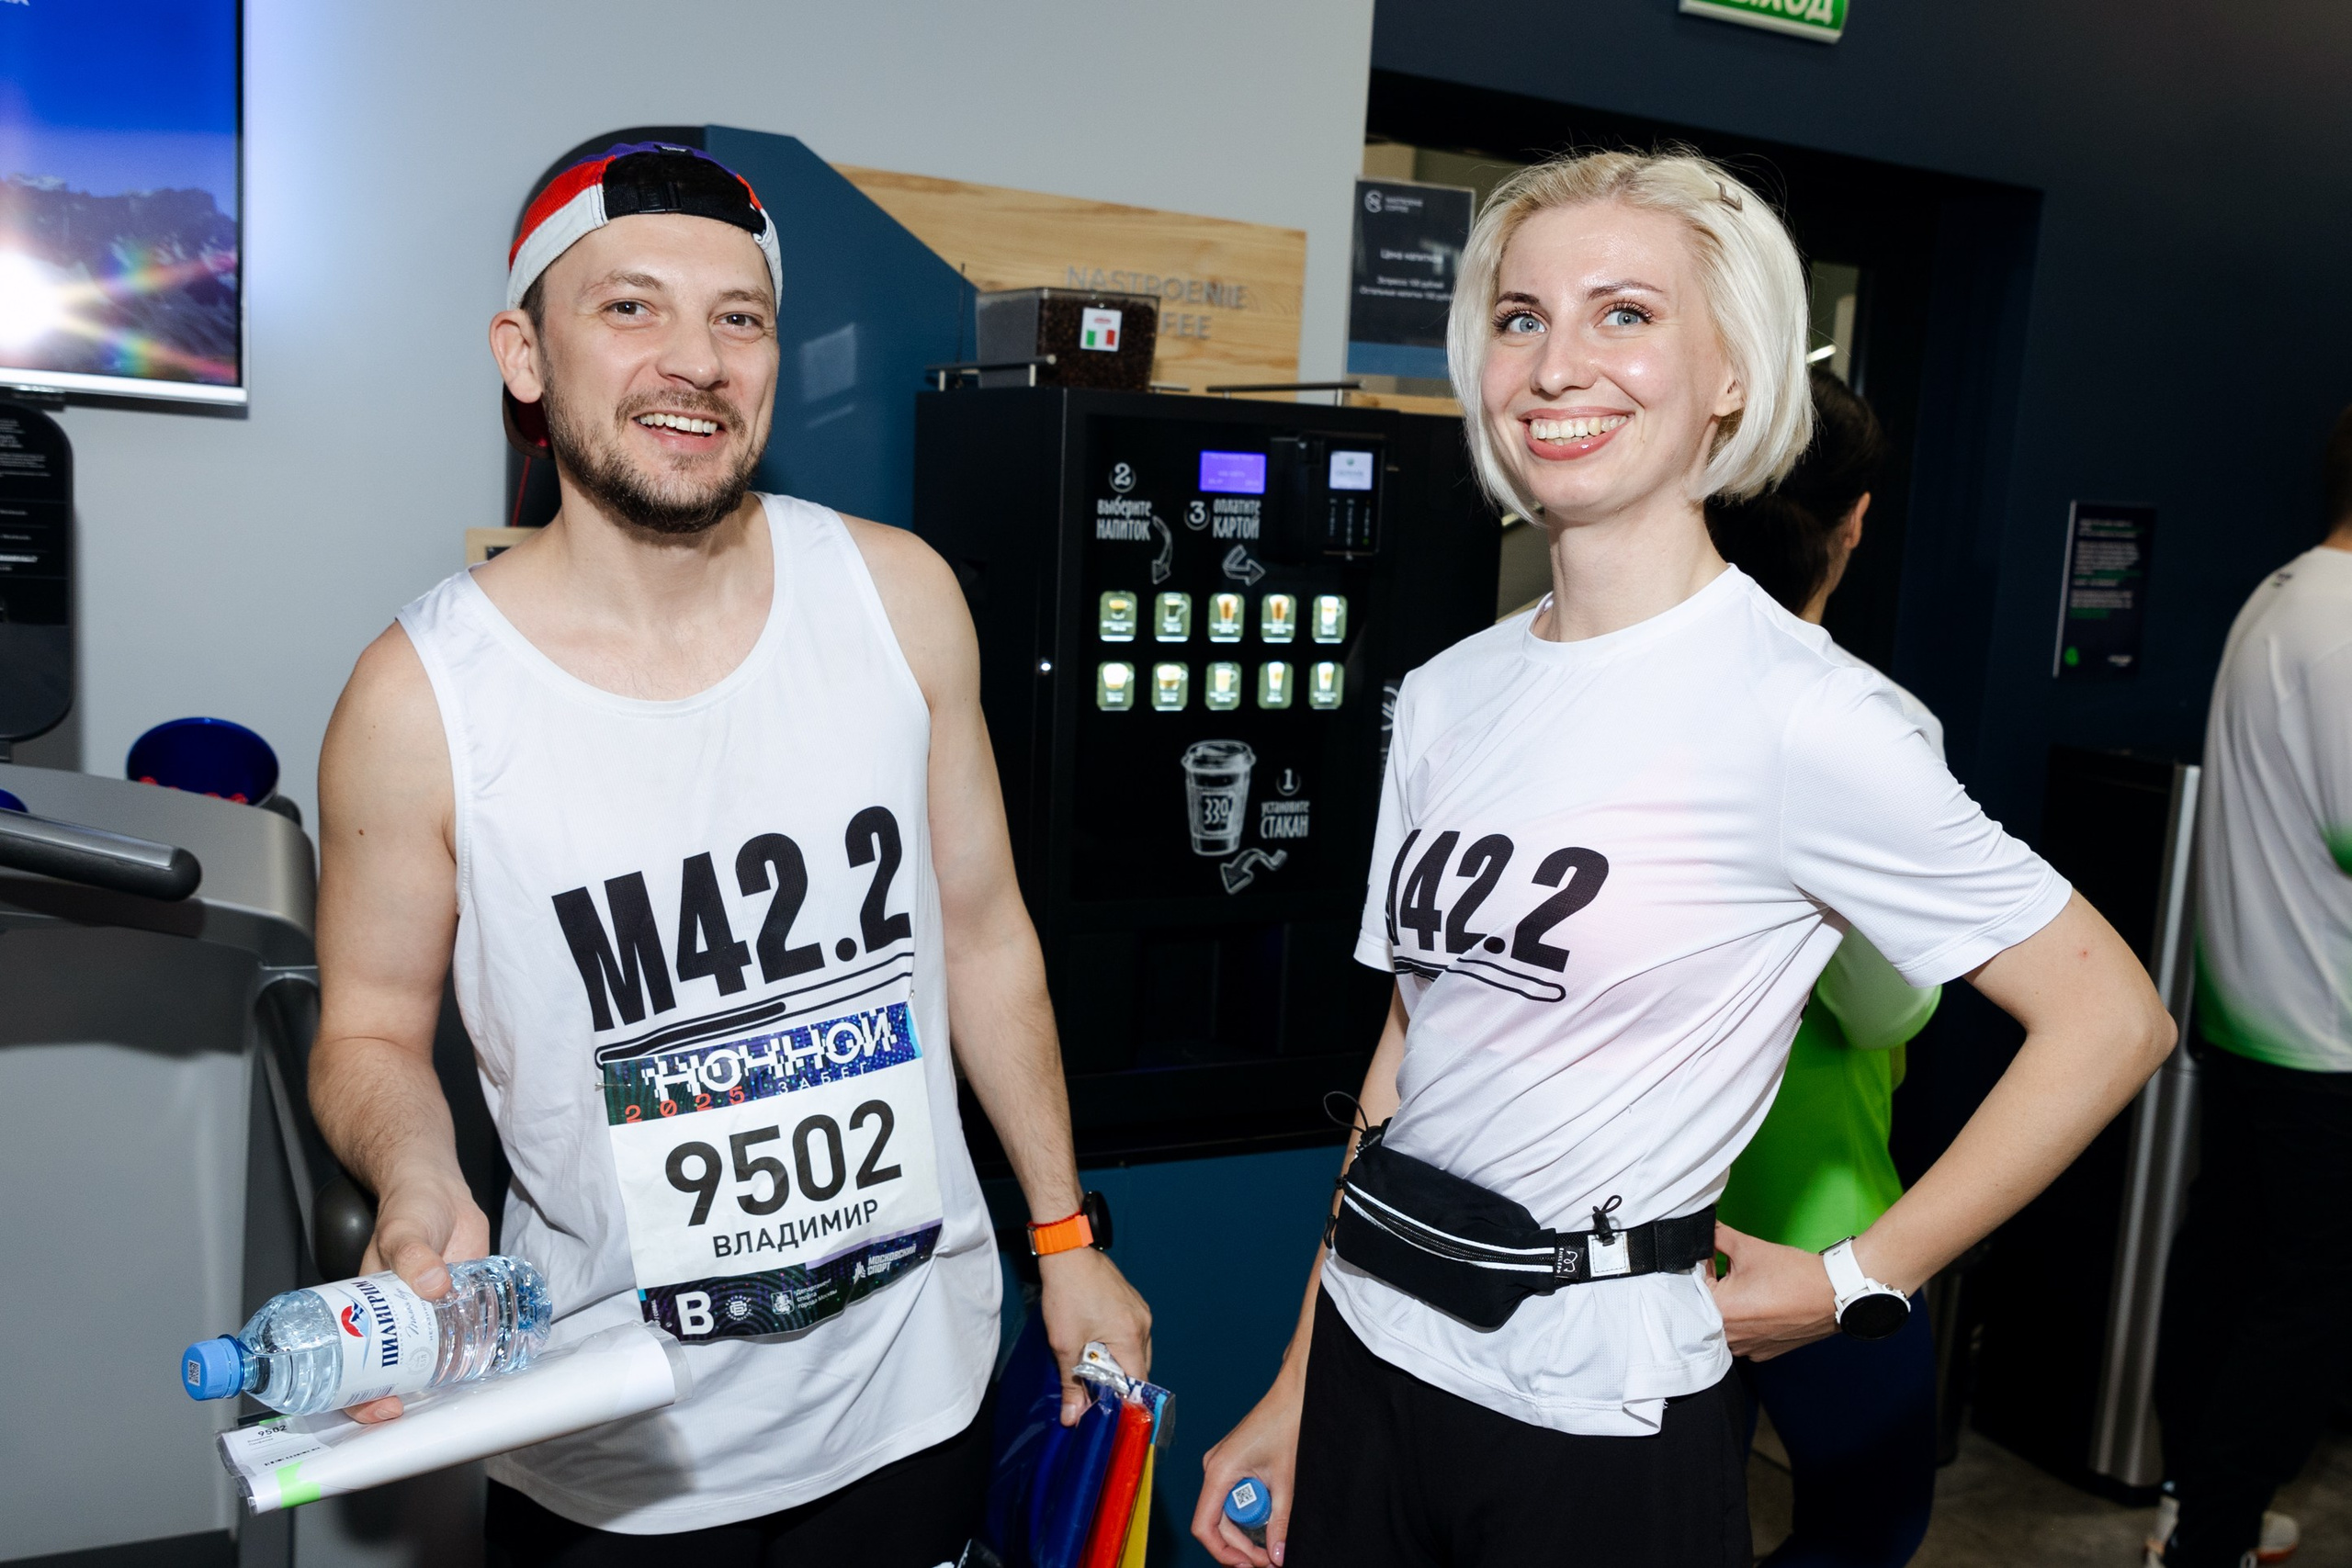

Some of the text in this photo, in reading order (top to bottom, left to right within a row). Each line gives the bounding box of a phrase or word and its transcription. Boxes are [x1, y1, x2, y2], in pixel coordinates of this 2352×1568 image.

[1067, 264, 1248, 310] NASTROENIE
[1114, 462, 1131, 486] 2
[1189, 501, 1206, 525] 3
[1095, 518, 1151, 541] НАПИТОК
[1283, 768, 1294, 790] 1
[1204, 797, 1229, 824] 330
[1260, 815, 1309, 840] СТАКАН
[551, 806, 912, 1032] M42.2
[625, 1085, 746, 1123] 2025
[664, 1099, 903, 1227] 9502
[712, 1199, 879, 1258] ВЛАДИМИР
[867, 1243, 917, 1265] МОСКОВСКИЙ
[867, 1261, 892, 1276] СПОРТ
[351, 1280, 399, 1369] ПИЛИГРИМ
[257, 1425, 288, 1437] 9502
